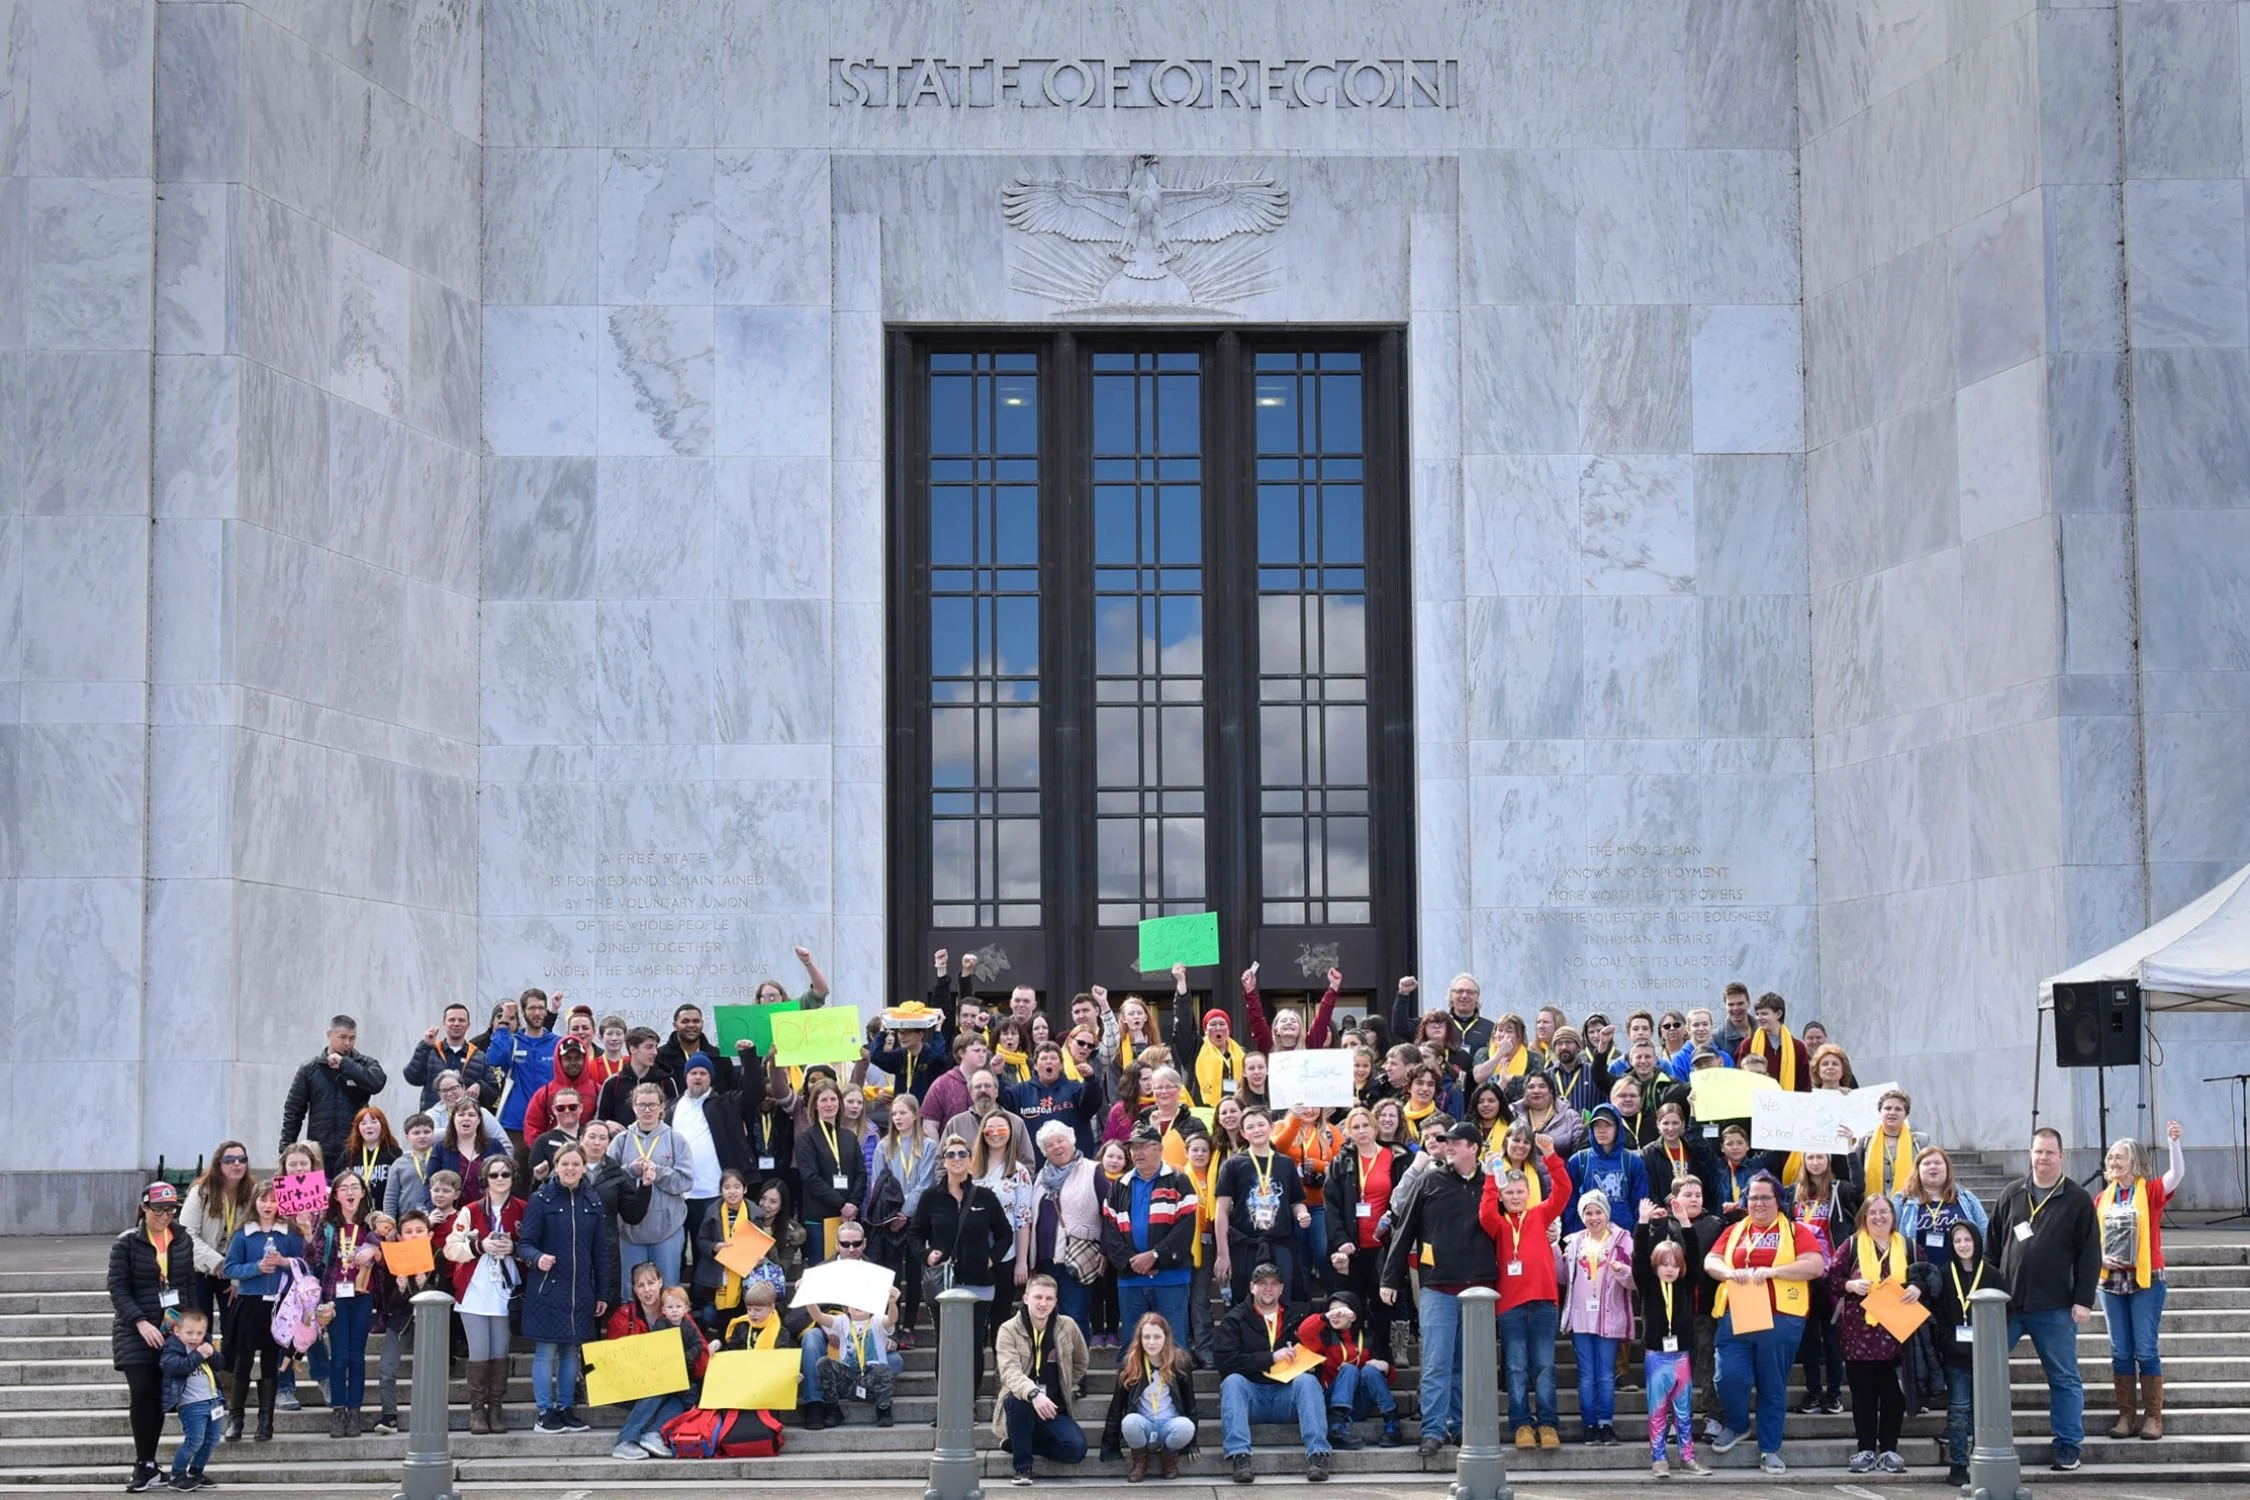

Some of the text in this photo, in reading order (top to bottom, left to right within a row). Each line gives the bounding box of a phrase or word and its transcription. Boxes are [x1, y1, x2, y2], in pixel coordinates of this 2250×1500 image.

[838, 58, 1458, 109] STATE OF OREGON
[1588, 846, 1702, 856] THE MIND OF MAN
[600, 853, 707, 864] A FREE STATE
[1564, 867, 1729, 879] KNOWS NO EMPLOYMENT
[550, 875, 764, 887] IS FORMED AND IS MAINTAINED
[1548, 889, 1744, 900] MORE WORTHY OF ITS POWERS
[565, 897, 748, 909] BY THE VOLUNTARY UNION
[1523, 911, 1769, 923] THAN THE QUEST OF RIGHTEOUSNESS
[575, 919, 729, 931] OF THE WHOLE PEOPLE
[1585, 933, 1598, 944] IN
[1605, 933, 1652, 944] HUMAN
[588, 942, 723, 953] JOINED TOGETHER
[1563, 956, 1735, 967] NO GOAL OF ITS LABOURS
[543, 964, 768, 977] UNDER THE SAME BODY OF LAWS
[1581, 978, 1710, 990] THAT IS SUPERIOR TO
[586, 987, 612, 998] THE
[621, 987, 684, 998] COMMON
[692, 987, 755, 998] WELFARE
[1577, 1000, 1650, 1012] DISCOVERY
[1655, 1000, 1673, 1012] OF
[1678, 1000, 1703, 1012] THE
[1758, 1095, 1780, 1112] We
[1760, 1124, 1794, 1140] School
[273, 1177, 285, 1189] I
[276, 1185, 320, 1202] Virtual
[279, 1195, 327, 1214] Schools!
